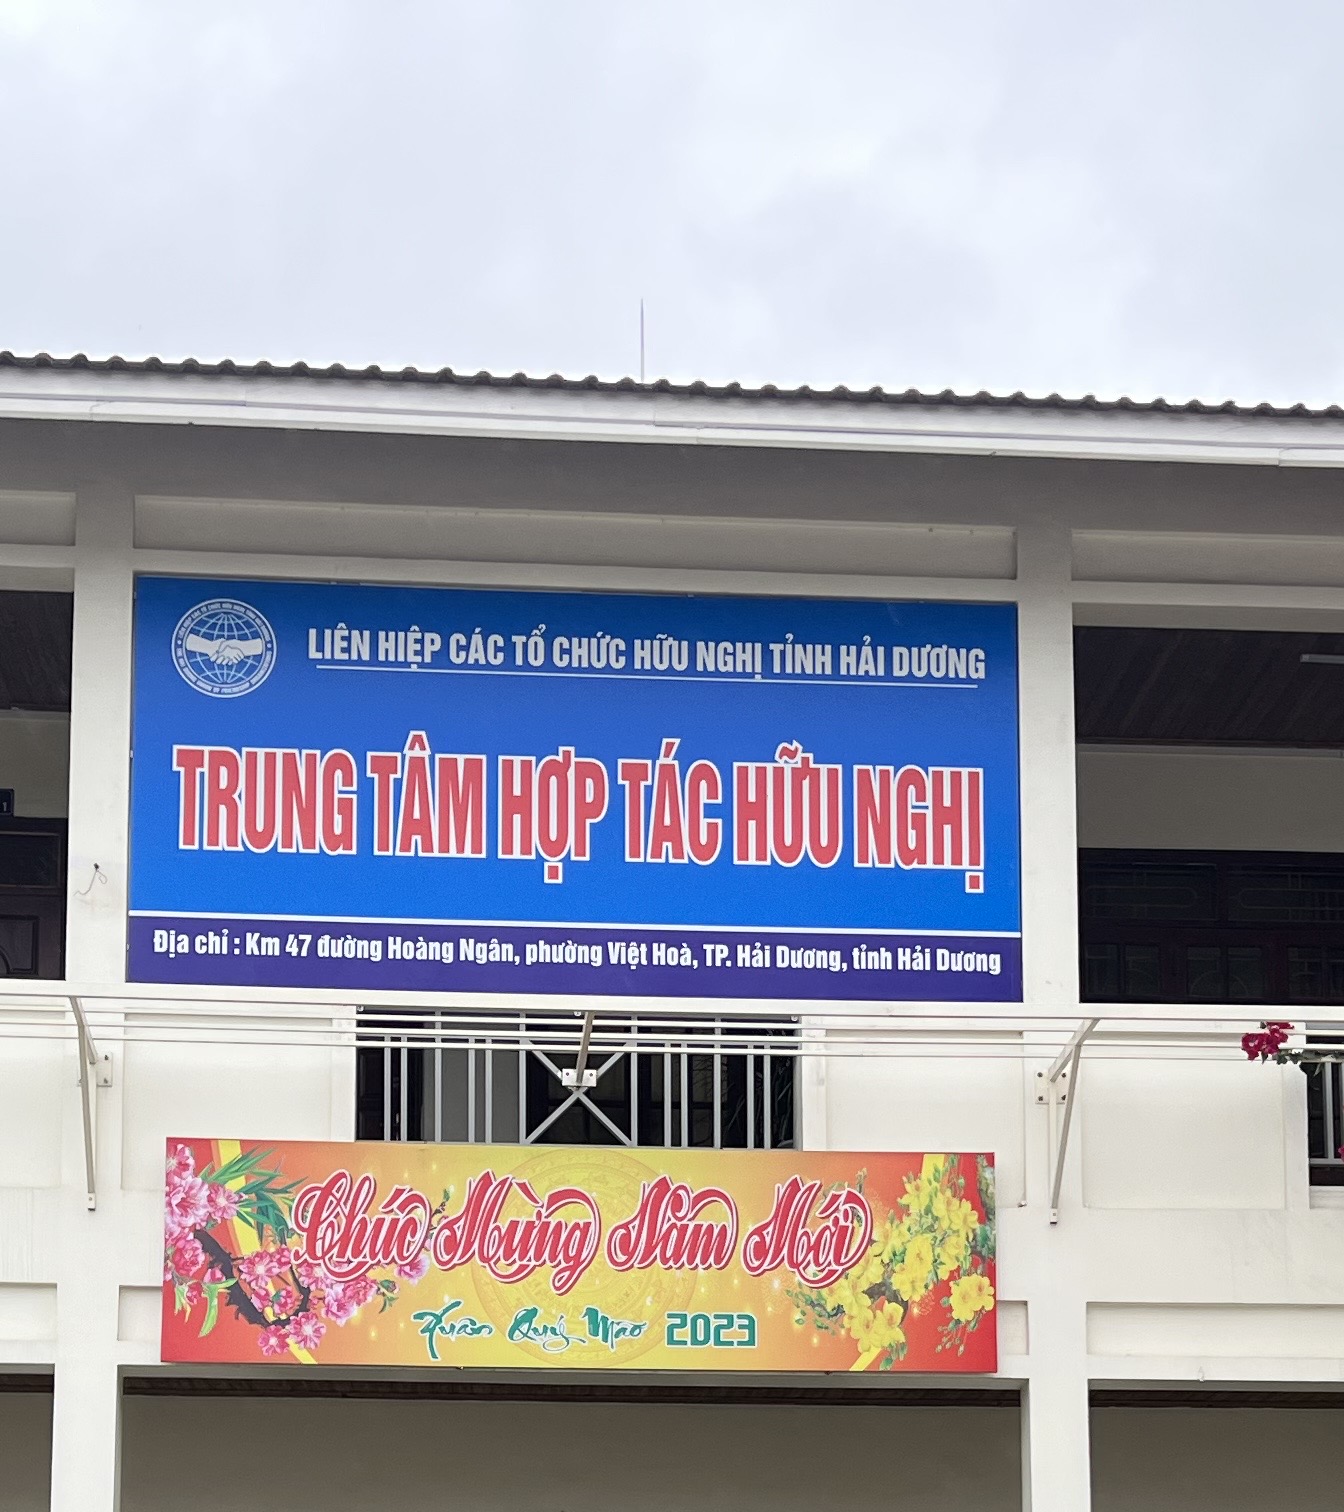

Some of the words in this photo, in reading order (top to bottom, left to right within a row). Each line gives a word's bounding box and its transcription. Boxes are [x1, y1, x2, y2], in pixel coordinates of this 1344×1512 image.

[308, 622, 371, 661] LIÊN
[378, 625, 442, 669] HIỆP
[449, 627, 505, 666] CÁC
[511, 623, 547, 667] TỔ
[552, 631, 627, 669] CHỨC
[633, 633, 689, 671] HỮU
[696, 640, 763, 680] NGHỊ
[769, 633, 833, 676] TỈNH
[839, 635, 885, 677] HẢI
[892, 643, 986, 680] DƯƠNG
[2, 802, 8, 812] 1
[172, 744, 357, 856] TRUNG
[366, 730, 487, 859] TÂM
[497, 746, 609, 884] HỢP
[617, 738, 723, 866] TÁC
[733, 741, 843, 868] HỮU
[853, 764, 985, 894] NGHỊ
[153, 929, 189, 958] Địa
[194, 928, 228, 955] chỉ
[246, 932, 280, 956] Km
[285, 934, 312, 957] 47
[317, 934, 382, 962] đường
[387, 936, 454, 964] Hoàng
[459, 938, 521, 965] Ngân,
[525, 940, 602, 967] phường
[607, 941, 648, 970] Việt
[652, 942, 699, 969] Hoà,
[703, 944, 732, 967] TP.
[737, 942, 771, 968] Hải
[775, 945, 848, 972] Dương,
[852, 944, 892, 970] tỉnh
[897, 945, 931, 971] Hải
[936, 948, 1002, 976] Dương
[290, 1168, 432, 1283] Chúc
[431, 1168, 602, 1297] Mừng
[741, 1174, 874, 1290] Mới
[410, 1300, 494, 1361] Xuân
[664, 1312, 758, 1347] 2023
